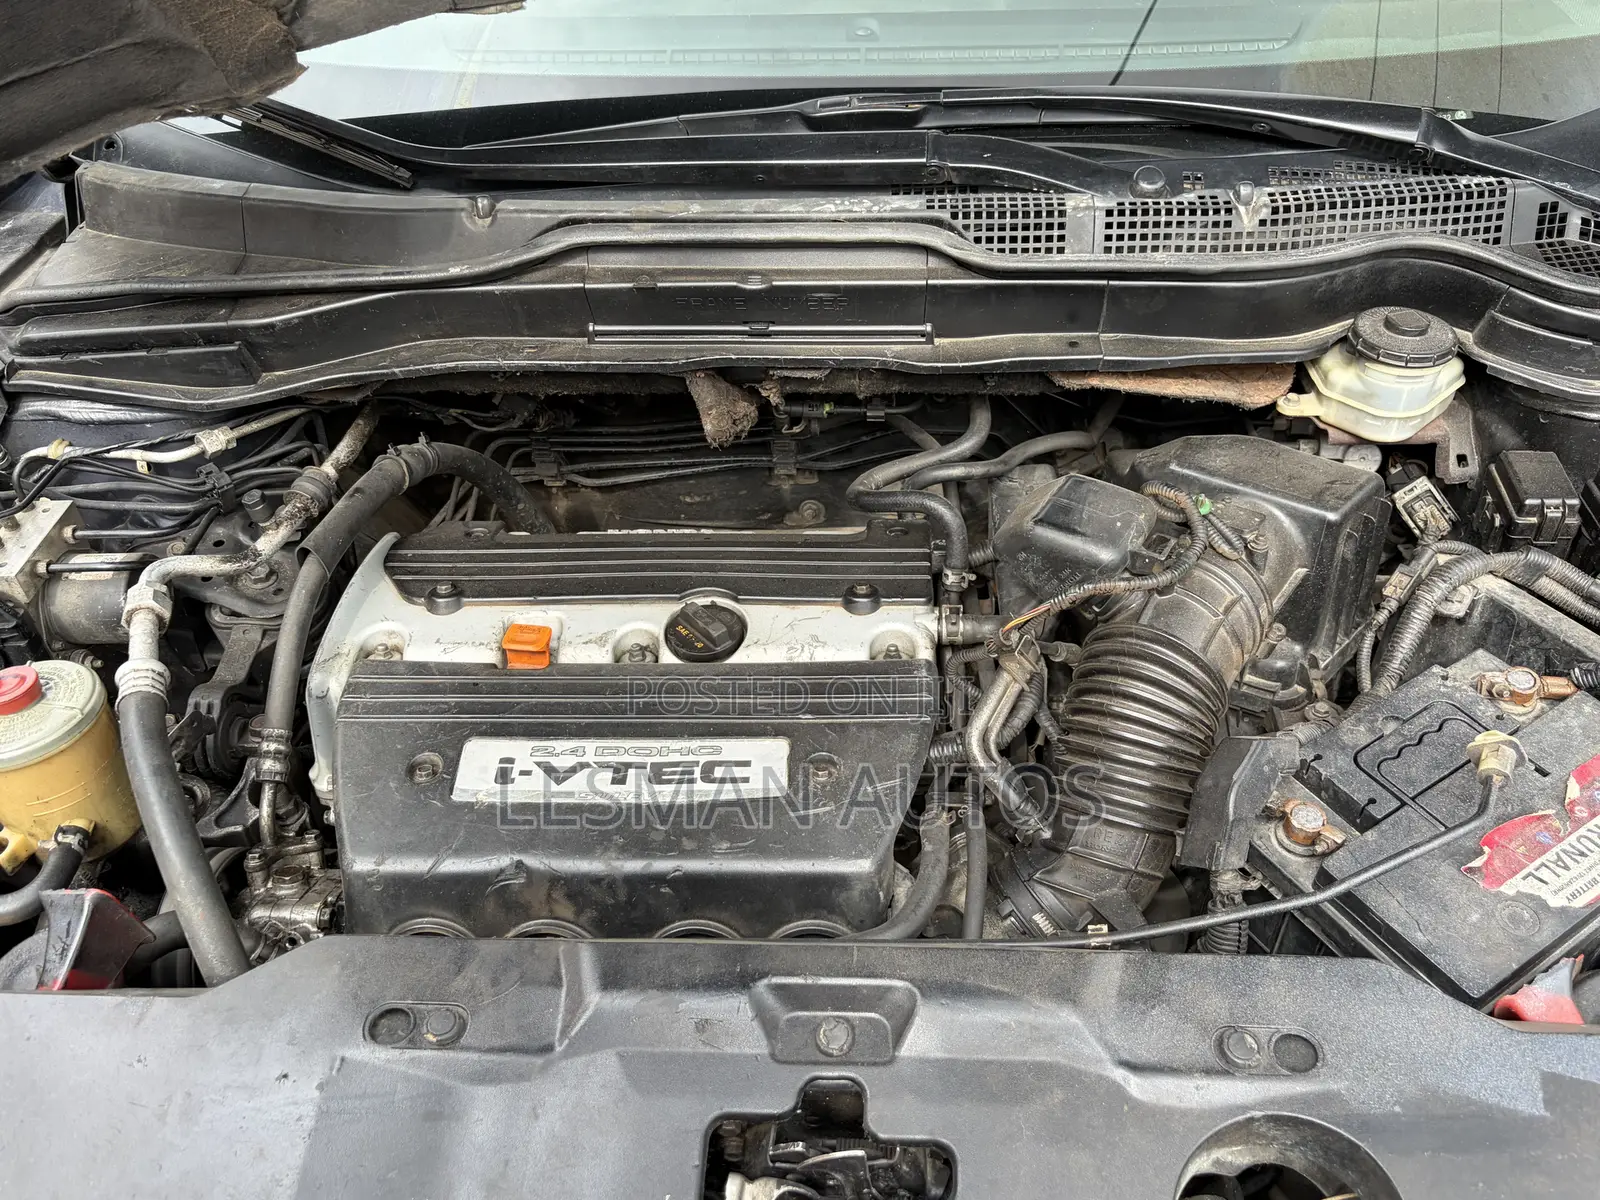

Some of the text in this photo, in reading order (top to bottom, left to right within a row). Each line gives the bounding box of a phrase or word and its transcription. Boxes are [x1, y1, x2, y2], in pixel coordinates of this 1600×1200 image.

[530, 745, 723, 758] 2.4 DOHC
[494, 756, 753, 787] i-VTEC
[1565, 876, 1599, 904] BATTERY
